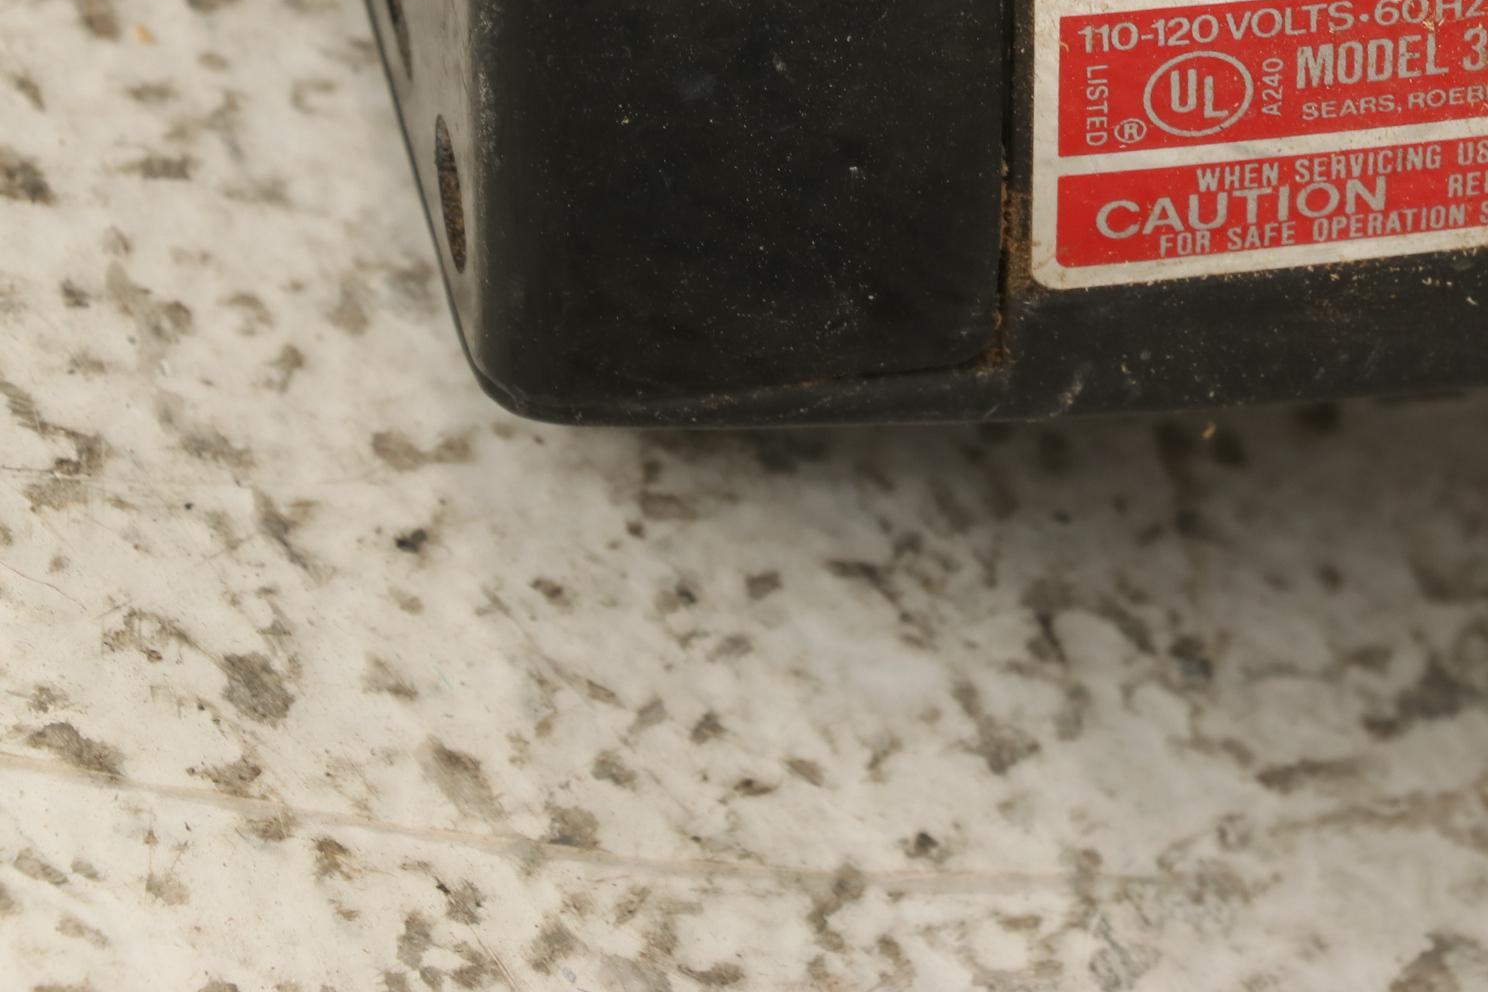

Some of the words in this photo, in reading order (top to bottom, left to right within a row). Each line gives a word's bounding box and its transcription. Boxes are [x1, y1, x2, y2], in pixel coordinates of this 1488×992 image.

[1261, 58, 1284, 116] A240
[1295, 32, 1450, 90] MODEL
[1085, 64, 1109, 147] LISTED
[1169, 68, 1230, 119] UL
[1301, 93, 1402, 121] SEARS,
[1196, 161, 1280, 193] WHEN
[1294, 144, 1442, 184] SERVICING
[1095, 175, 1387, 240] CAUTION
[1157, 229, 1211, 258] FOR
[1225, 220, 1297, 252] SAFE
[1311, 202, 1467, 243] OPERATION
